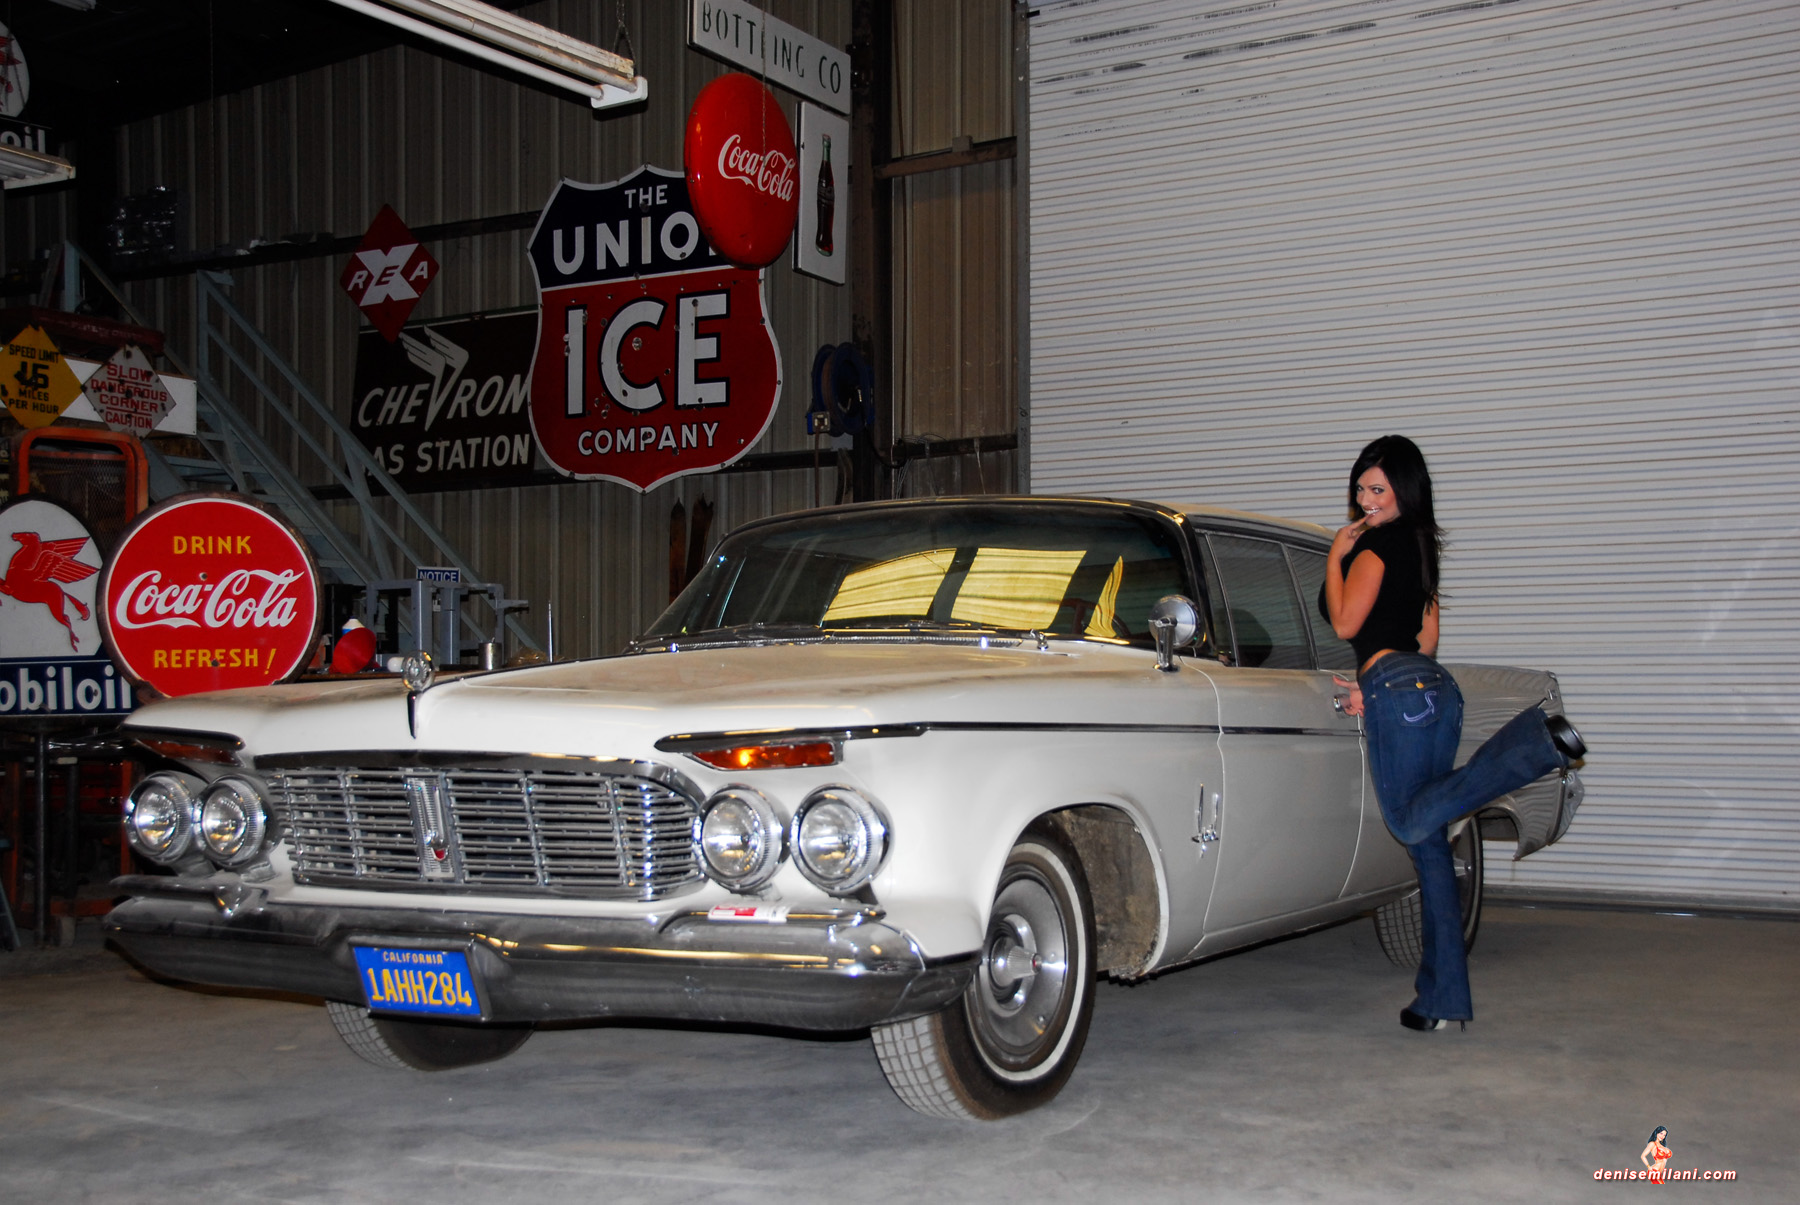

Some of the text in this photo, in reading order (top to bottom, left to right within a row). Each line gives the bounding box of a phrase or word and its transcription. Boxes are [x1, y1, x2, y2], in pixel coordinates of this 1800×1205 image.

[818, 55, 841, 94] CO
[624, 184, 668, 209] THE
[553, 211, 717, 275] UNIO
[347, 261, 429, 292] REA
[9, 344, 60, 363] SPEED LIMIT
[566, 292, 728, 415] ICE
[107, 364, 152, 382] SLOW
[18, 388, 49, 401] MILES
[91, 379, 168, 402] DANGEROUS
[357, 340, 530, 432] CHEVRON
[8, 398, 59, 415] PER HOUR
[100, 395, 158, 413] CORNER
[105, 412, 153, 429] CAUTION
[578, 422, 720, 456] COMPANY
[416, 433, 531, 474] STATION
[173, 536, 252, 554] DRINK
[419, 571, 457, 583] NOTICE
[116, 568, 305, 629] Coca-Cola
[0, 665, 132, 713] obiloil
[383, 951, 443, 965] CALIFORNIA
[367, 968, 472, 1007] 1AHH284
